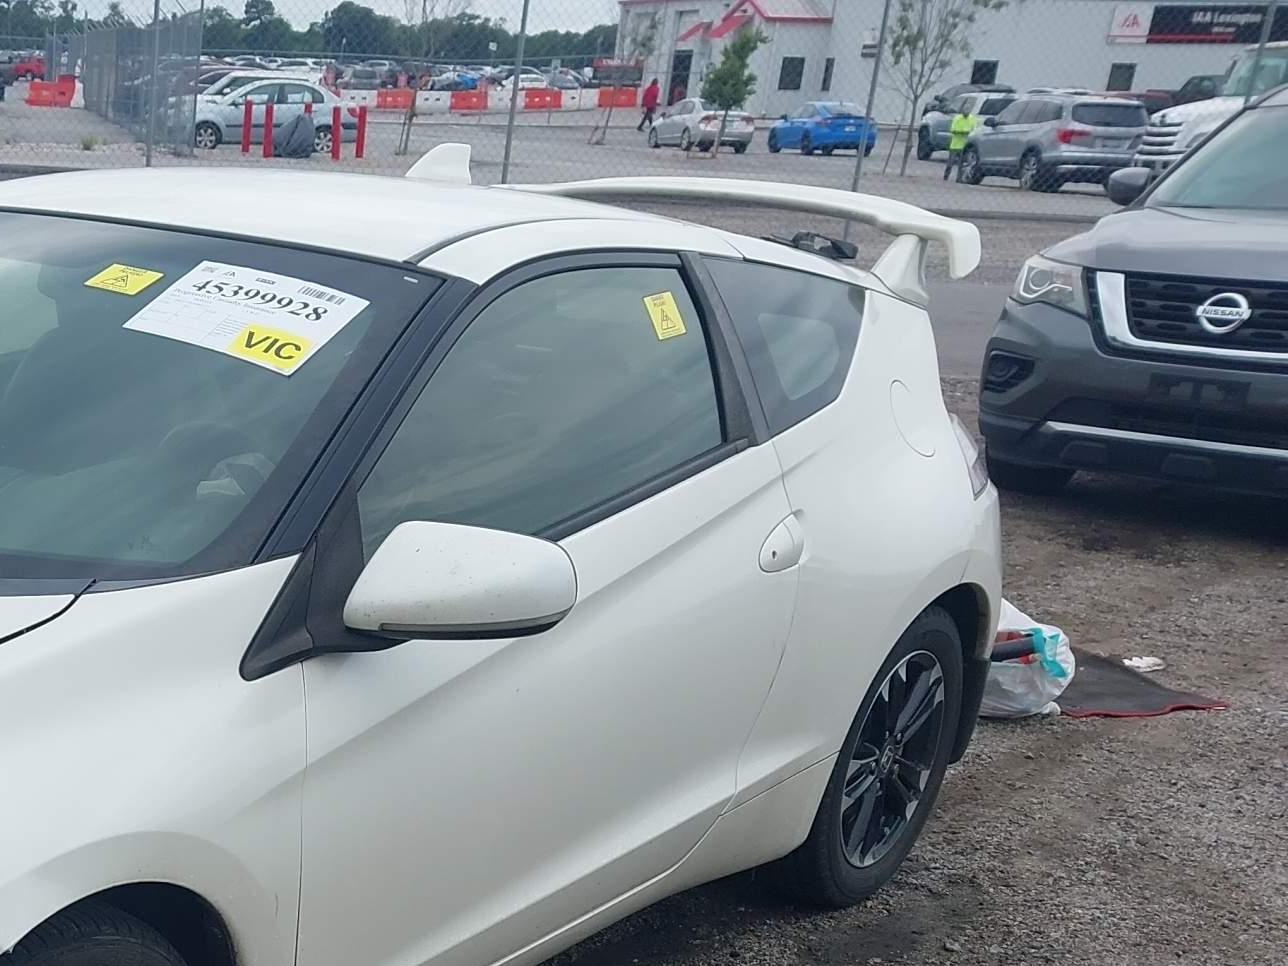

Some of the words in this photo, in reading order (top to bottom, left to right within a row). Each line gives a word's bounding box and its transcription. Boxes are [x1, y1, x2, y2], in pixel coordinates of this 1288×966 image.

[192, 279, 329, 322] 45399928
[1202, 307, 1244, 317] NISSAN
[244, 330, 301, 360] VIC
